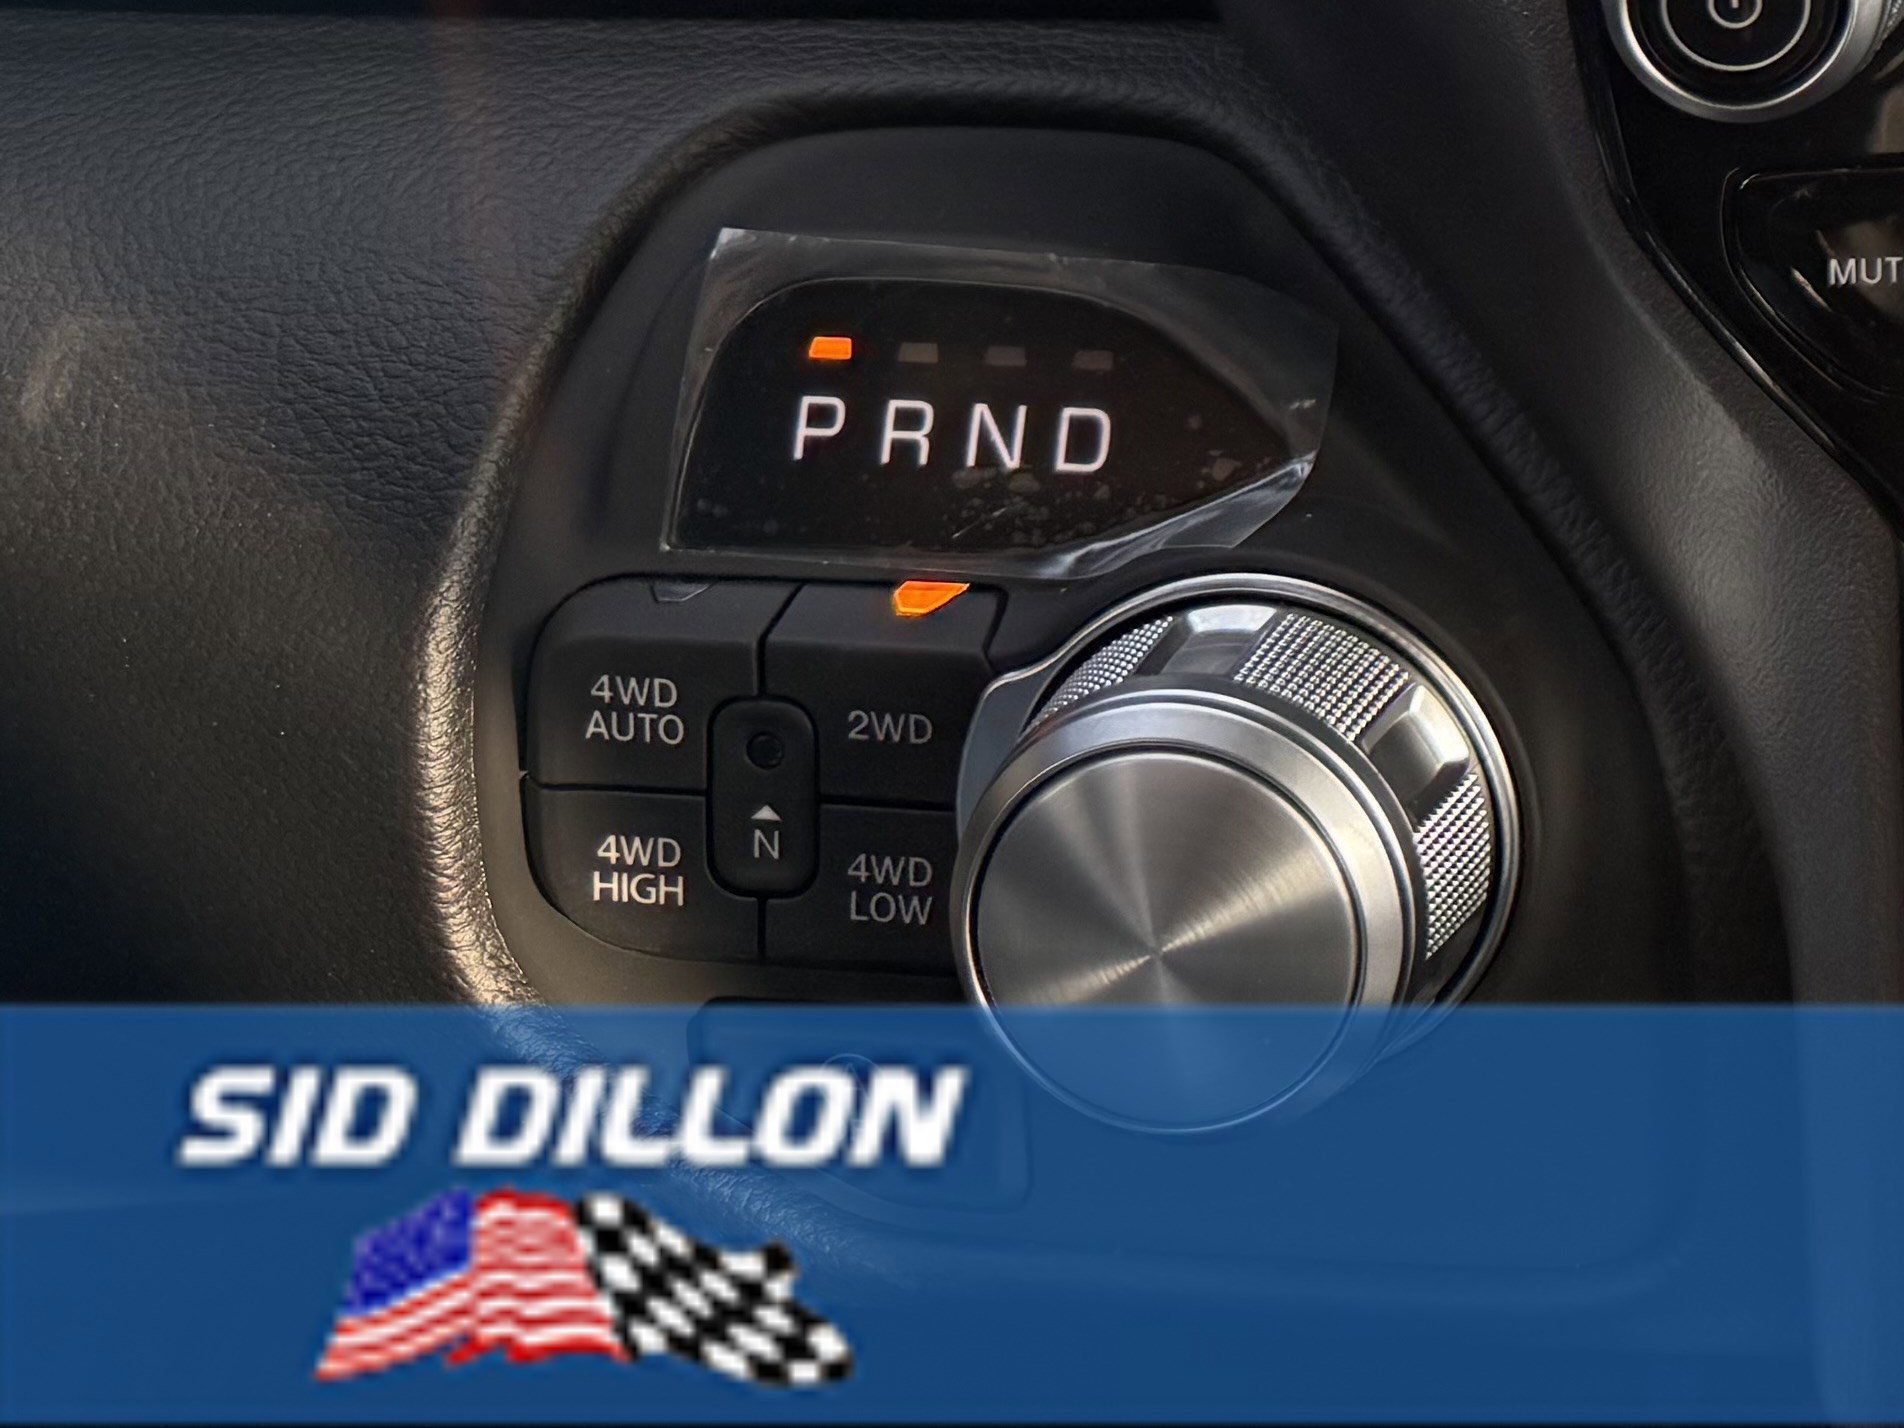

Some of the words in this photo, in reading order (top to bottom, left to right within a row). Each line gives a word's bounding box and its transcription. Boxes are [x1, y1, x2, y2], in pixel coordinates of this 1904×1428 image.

[792, 396, 847, 462] P
[880, 400, 934, 467] R
[966, 403, 1027, 470] N
[1054, 406, 1114, 474] D
[590, 675, 678, 708] 4WD
[584, 711, 686, 745] AUTO
[847, 711, 934, 745] 2WD
[596, 837, 682, 869] 4WD
[752, 830, 781, 861] N
[847, 853, 934, 888] 4WD
[593, 872, 685, 907] HIGH
[849, 890, 932, 924] LOW
